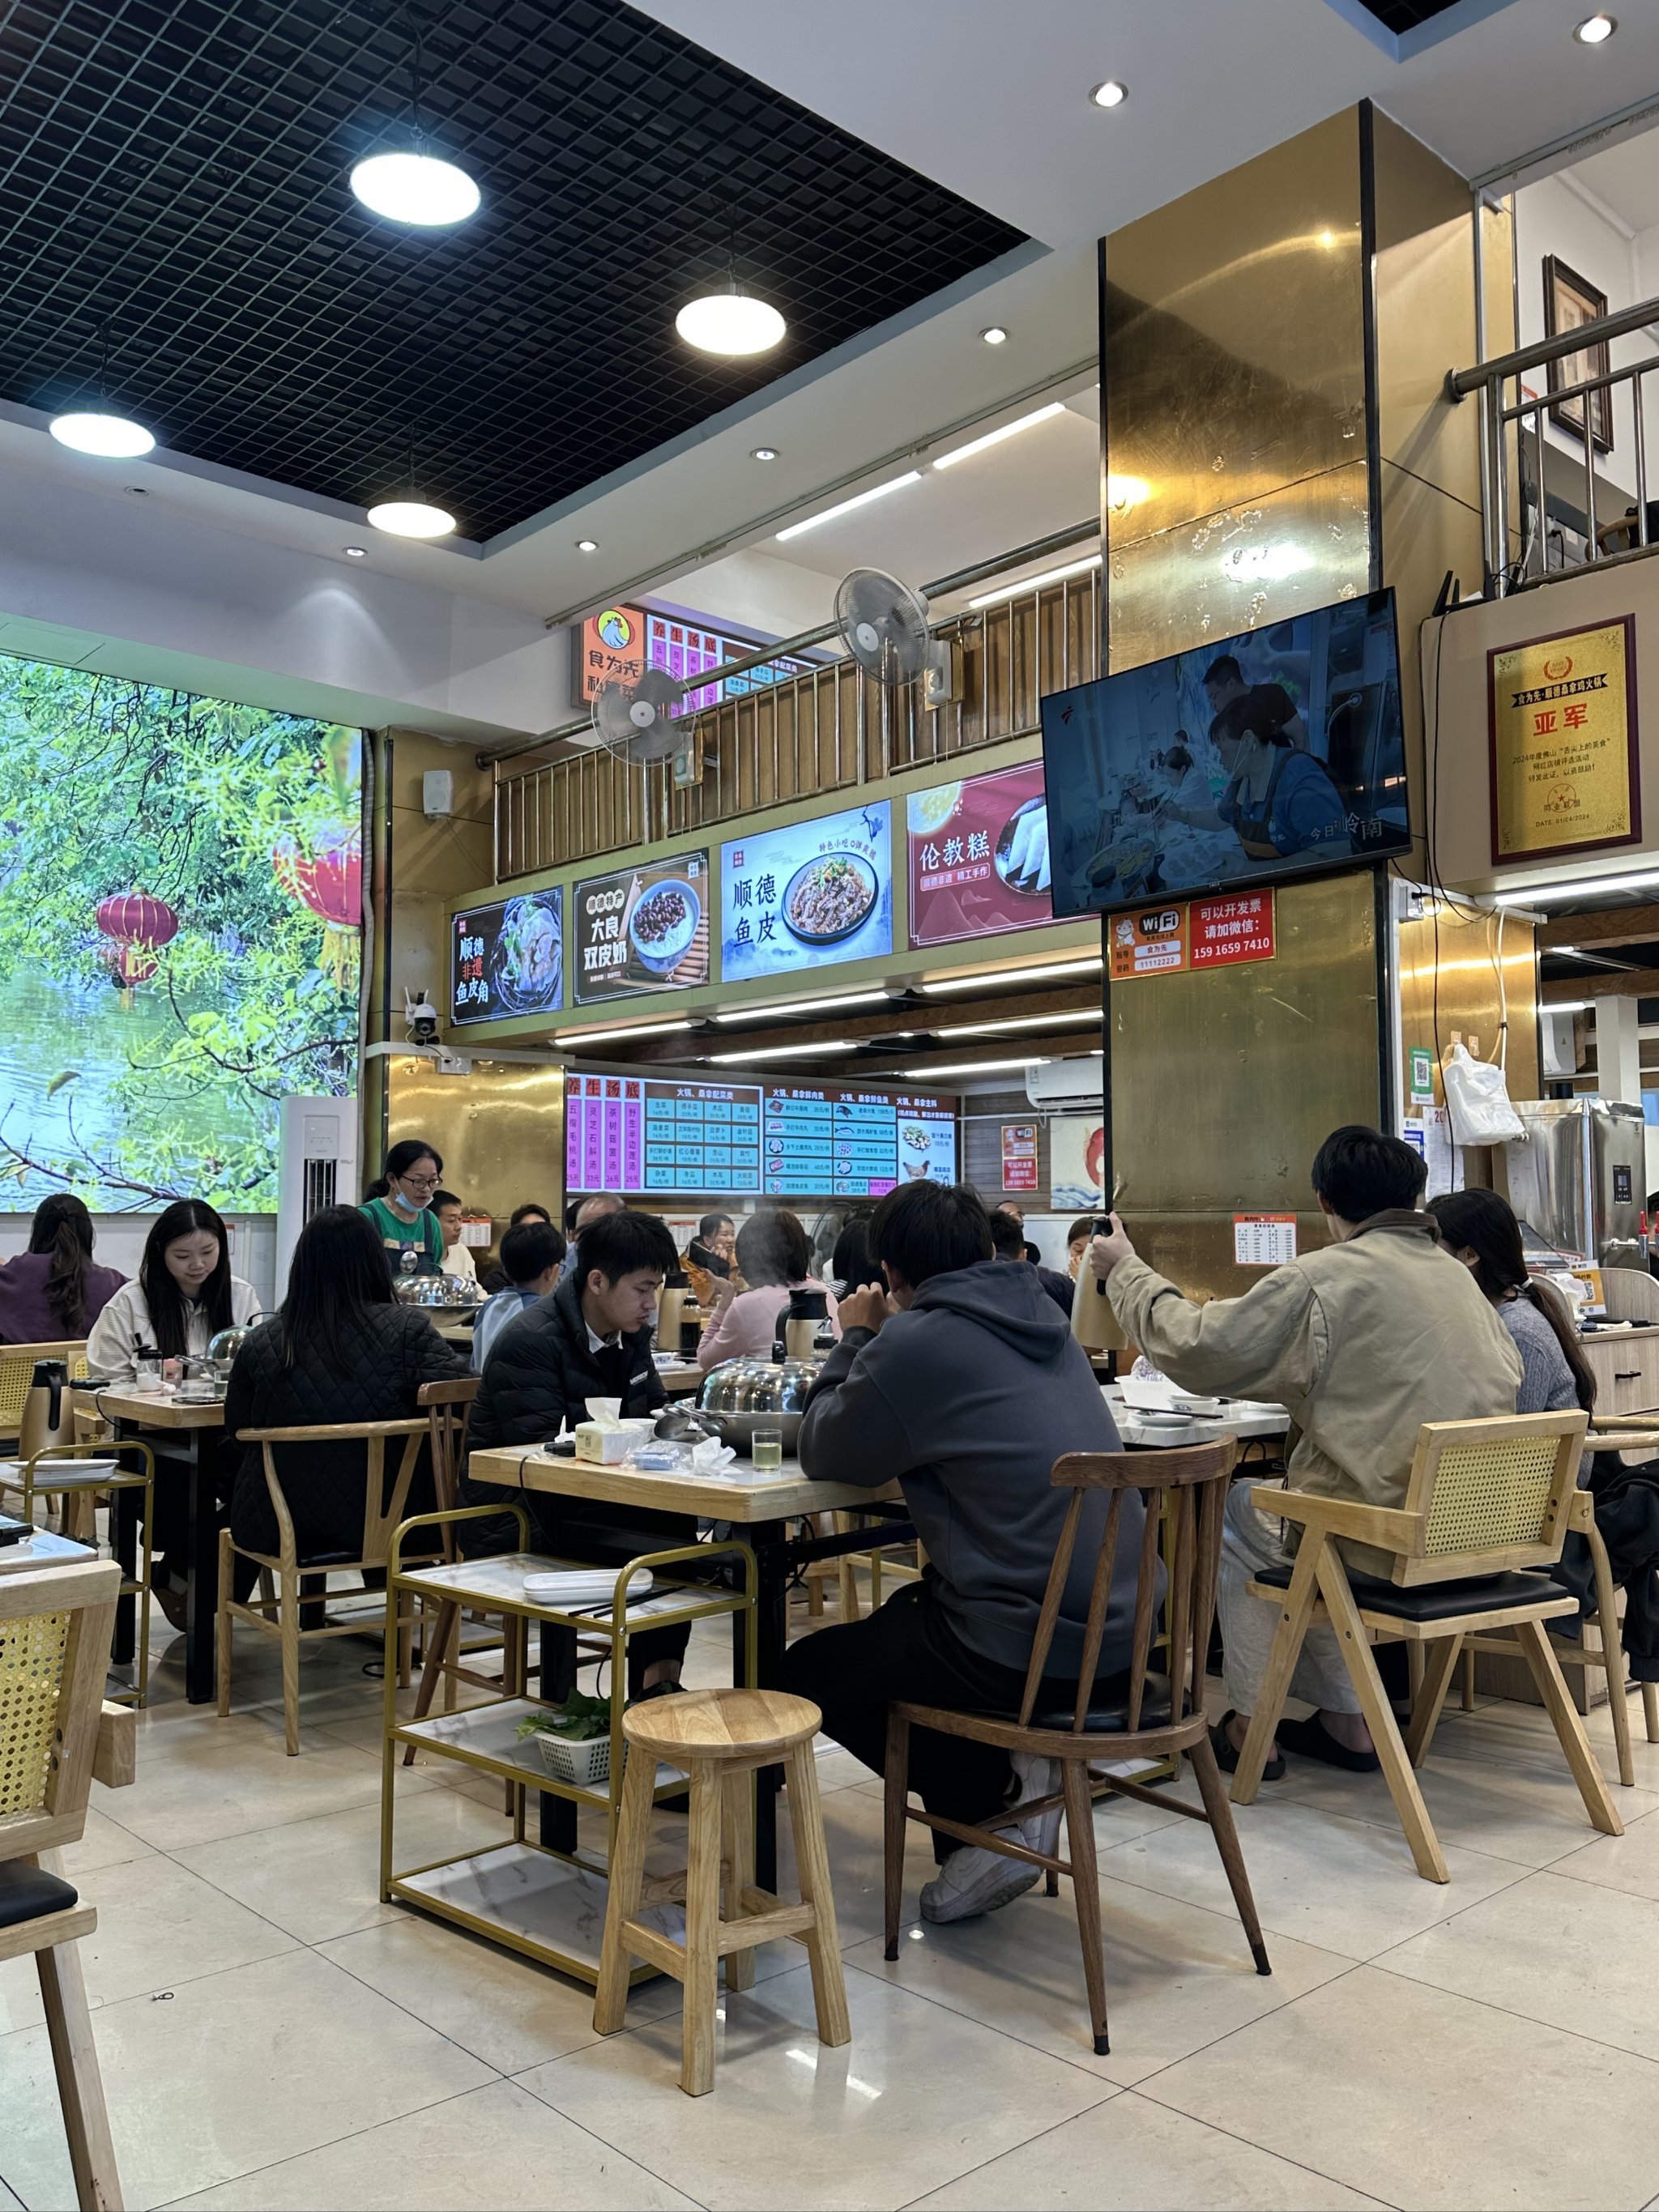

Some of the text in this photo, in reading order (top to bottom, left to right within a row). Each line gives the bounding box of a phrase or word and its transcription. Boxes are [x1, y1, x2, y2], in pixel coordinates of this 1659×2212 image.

[1533, 703, 1588, 736] 亚军
[1311, 825, 1334, 841] 今日
[919, 829, 990, 872] 伦教糕
[957, 866, 987, 881] 精工手作
[587, 892, 623, 911] 顺德特产
[733, 873, 776, 911] 顺德
[1201, 897, 1261, 921] 可以开发票
[591, 915, 619, 942] 大良
[733, 910, 777, 948] 鱼皮
[1142, 913, 1177, 931] WiFi
[459, 936, 484, 961] 顺德
[584, 940, 627, 970] 双皮奶
[1147, 944, 1167, 954] 食为先
[1194, 937, 1270, 959] 159 1659 7410
[463, 957, 483, 980] 非遗
[1141, 957, 1175, 969] 11112222
[455, 977, 489, 1005] 鱼皮角
[568, 1077, 639, 1098] 养生汤底
